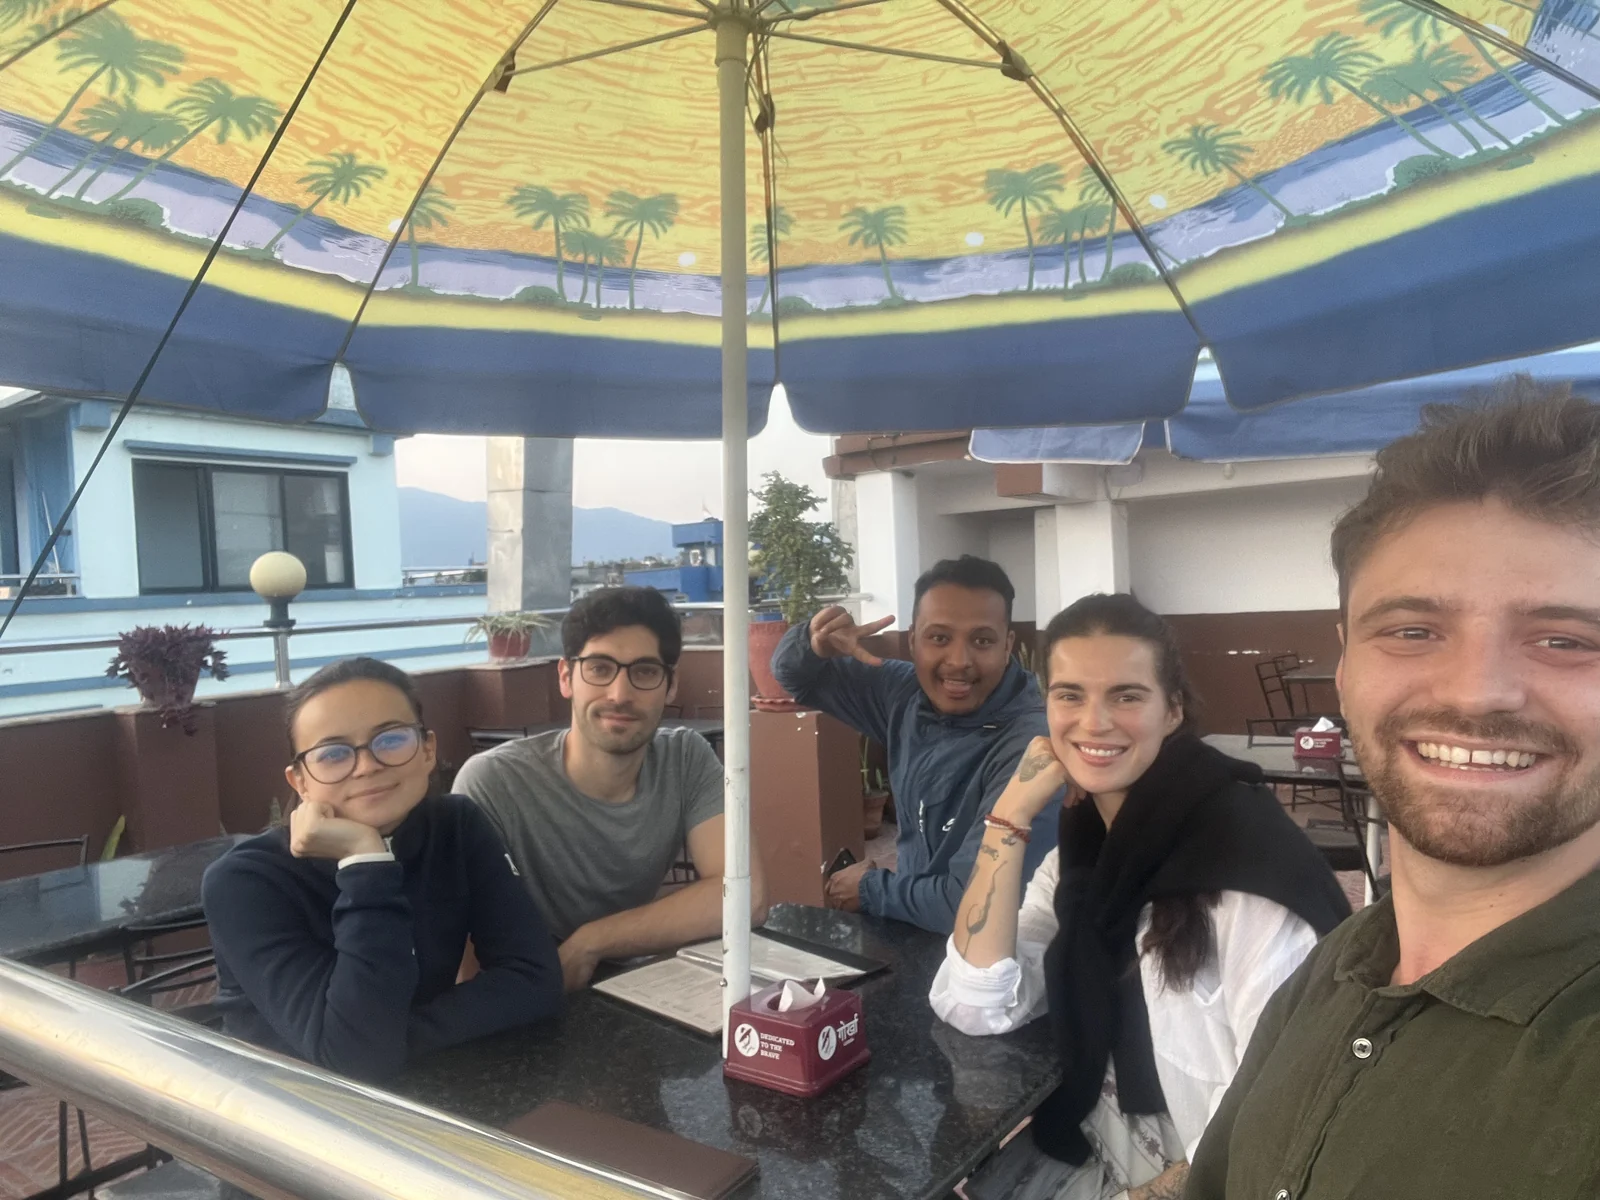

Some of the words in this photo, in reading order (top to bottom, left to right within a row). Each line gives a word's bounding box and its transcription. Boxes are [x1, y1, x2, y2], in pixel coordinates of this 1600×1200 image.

[760, 1033, 795, 1046] DEDICATED
[760, 1041, 769, 1049] TO
[770, 1043, 782, 1052] THE
[760, 1049, 780, 1060] BRAVE
